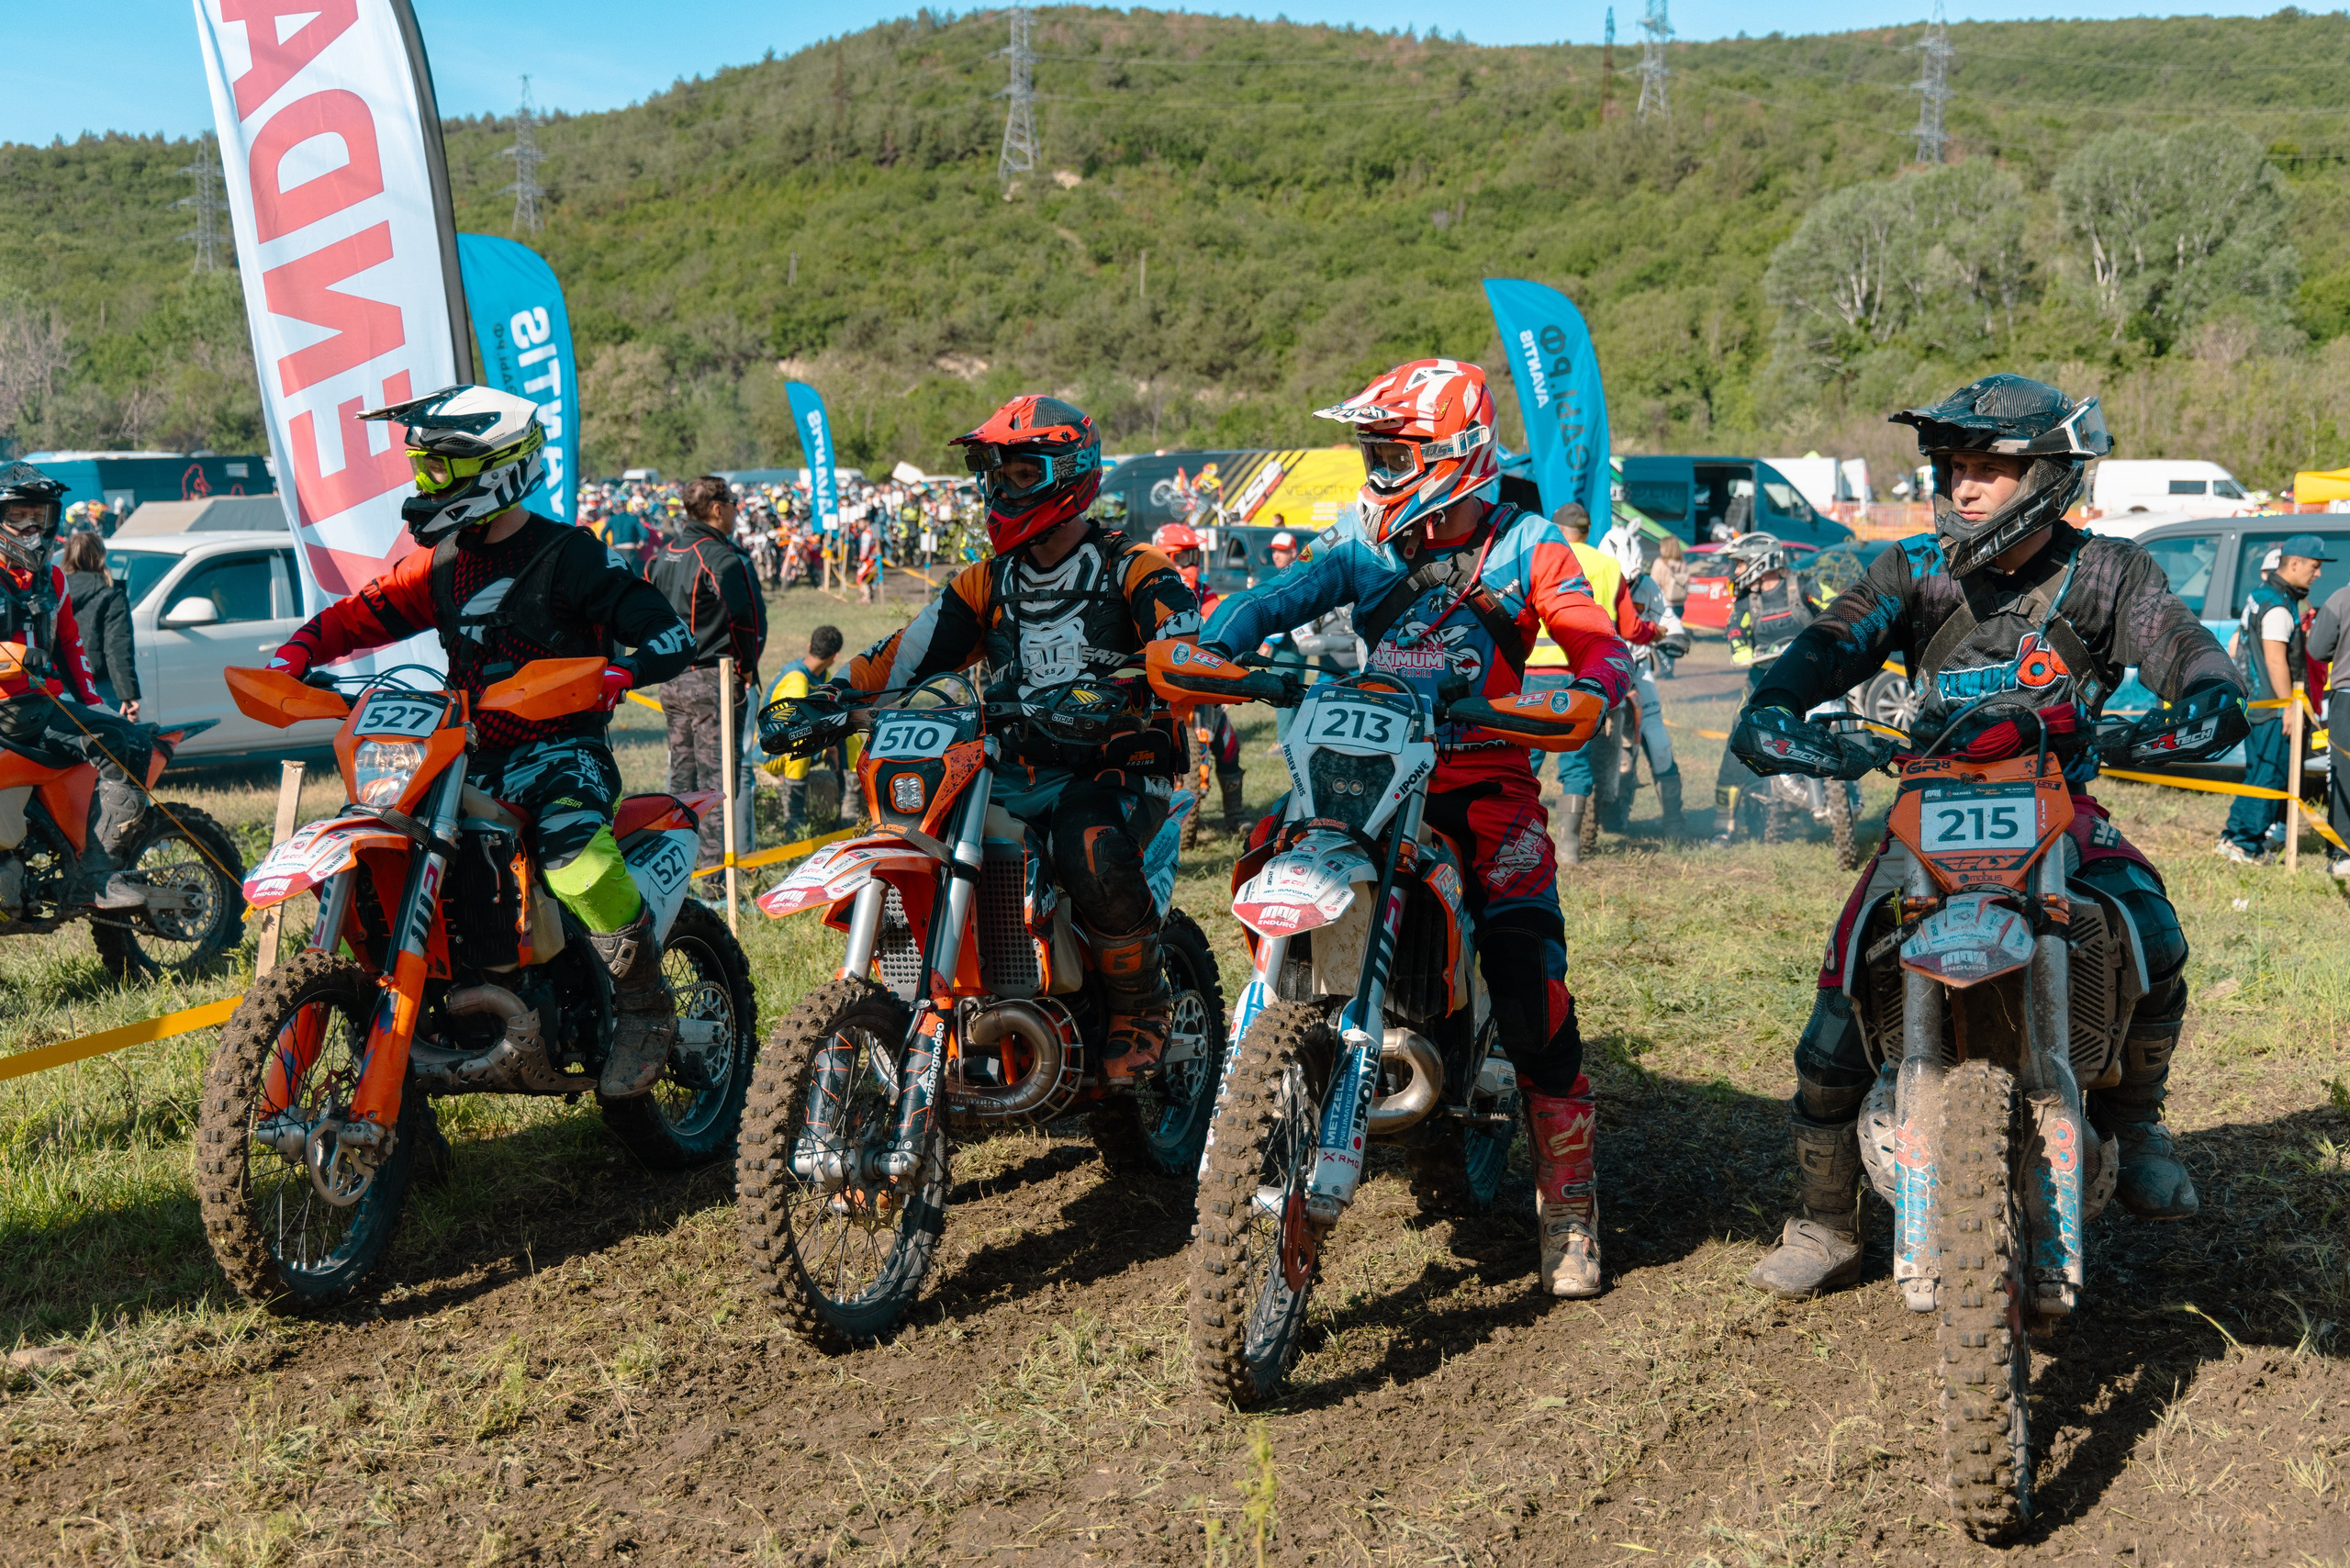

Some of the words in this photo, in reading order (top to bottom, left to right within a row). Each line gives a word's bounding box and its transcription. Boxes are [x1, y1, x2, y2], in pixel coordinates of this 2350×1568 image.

[1401, 669, 1432, 678] CRIMEA
[363, 706, 433, 730] 527
[1052, 712, 1074, 725] CYCRA
[1322, 708, 1393, 744] 213
[789, 726, 813, 741] CYCRA
[878, 726, 940, 752] 510
[1128, 750, 1155, 762] KTM
[1283, 743, 1297, 771] PATSEV
[1292, 772, 1306, 798] BORIS
[1399, 759, 1430, 795] IPONE
[1937, 806, 2019, 842] 215
[652, 845, 688, 885] 527
[252, 890, 285, 898] ENDURO
[1258, 919, 1296, 928] ENDURO
[1942, 965, 1988, 973] ENDURO
[925, 1022, 945, 1106] erzbergrodeo
[1353, 1046, 1380, 1132] IPONE
[1326, 1069, 1348, 1145] METZELE
[1339, 1094, 1353, 1147] PNEUMATICI
[1348, 1076, 1356, 1092] PER
[1338, 1155, 1360, 1169] RMG
